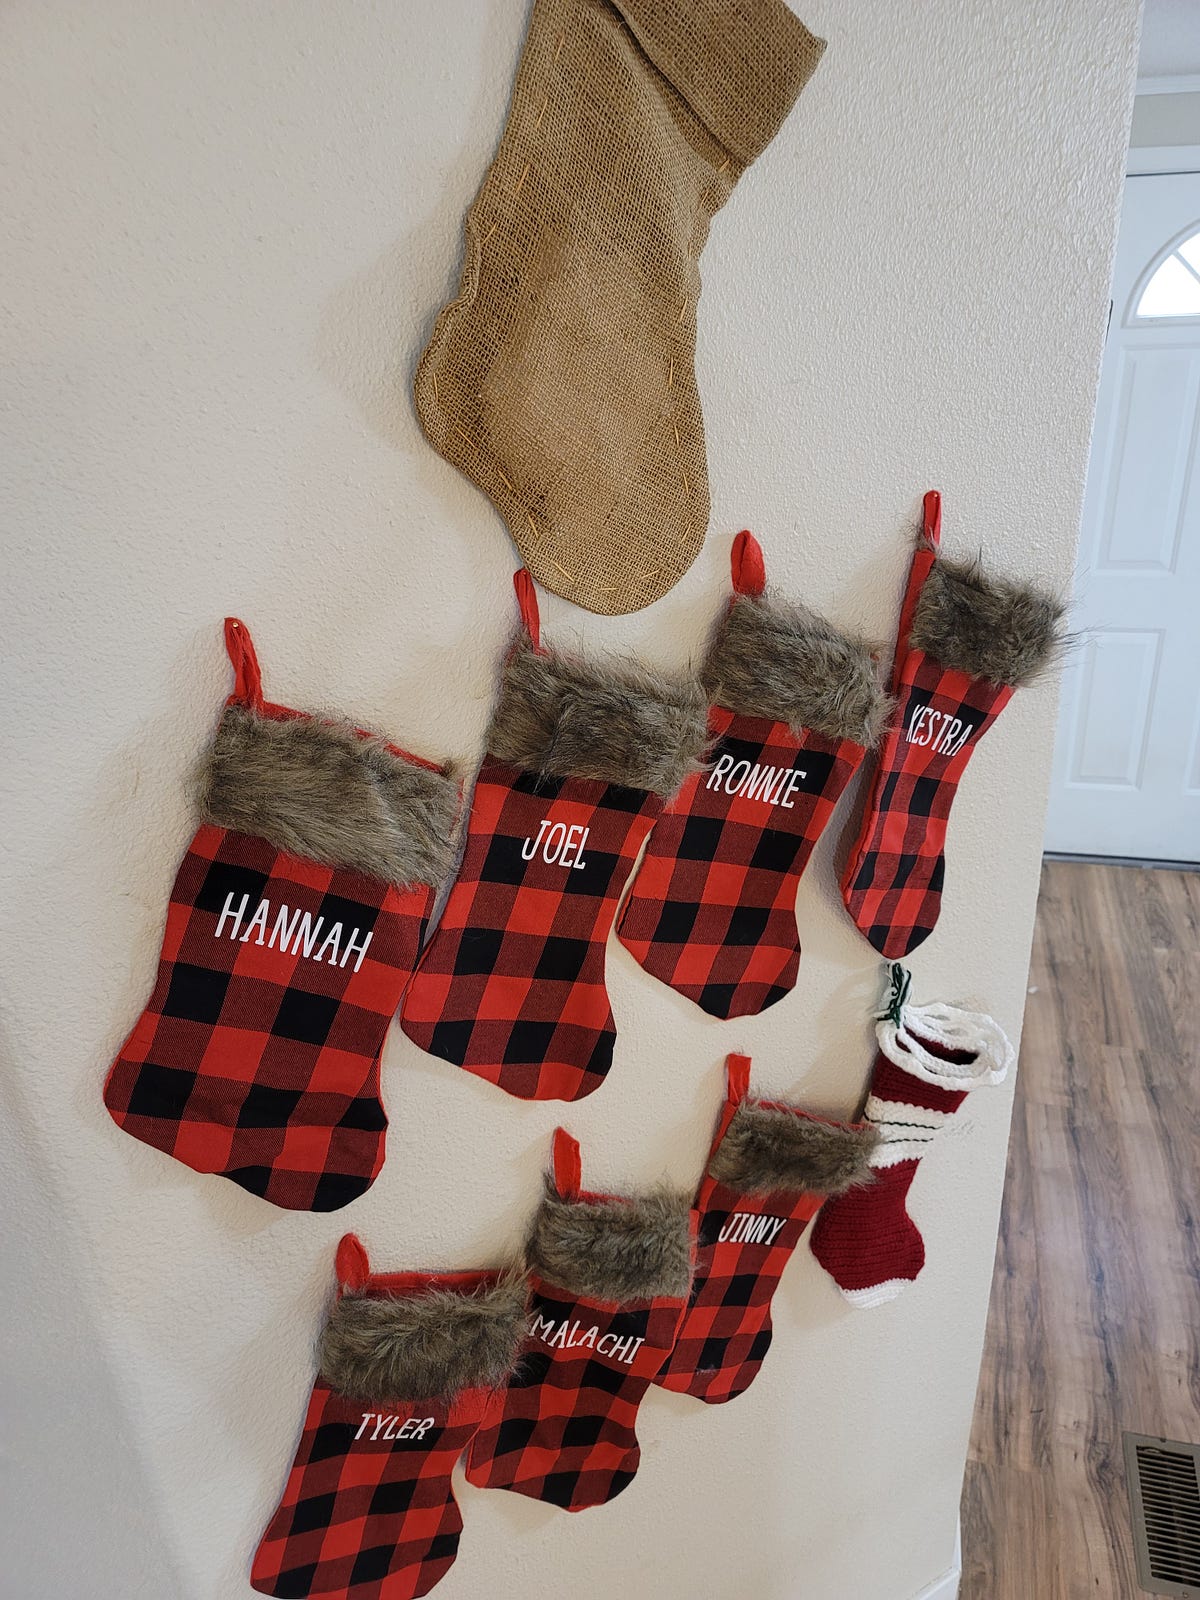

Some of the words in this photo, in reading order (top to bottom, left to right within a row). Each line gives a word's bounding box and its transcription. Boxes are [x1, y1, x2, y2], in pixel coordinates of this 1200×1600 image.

[905, 704, 973, 757] KESTRA
[705, 754, 807, 809] RONNIE
[521, 819, 590, 870] JOEL
[214, 891, 374, 973] HANNAH
[718, 1213, 787, 1245] JINNY
[527, 1314, 646, 1364] MALACHI
[354, 1413, 435, 1441] TYLER
